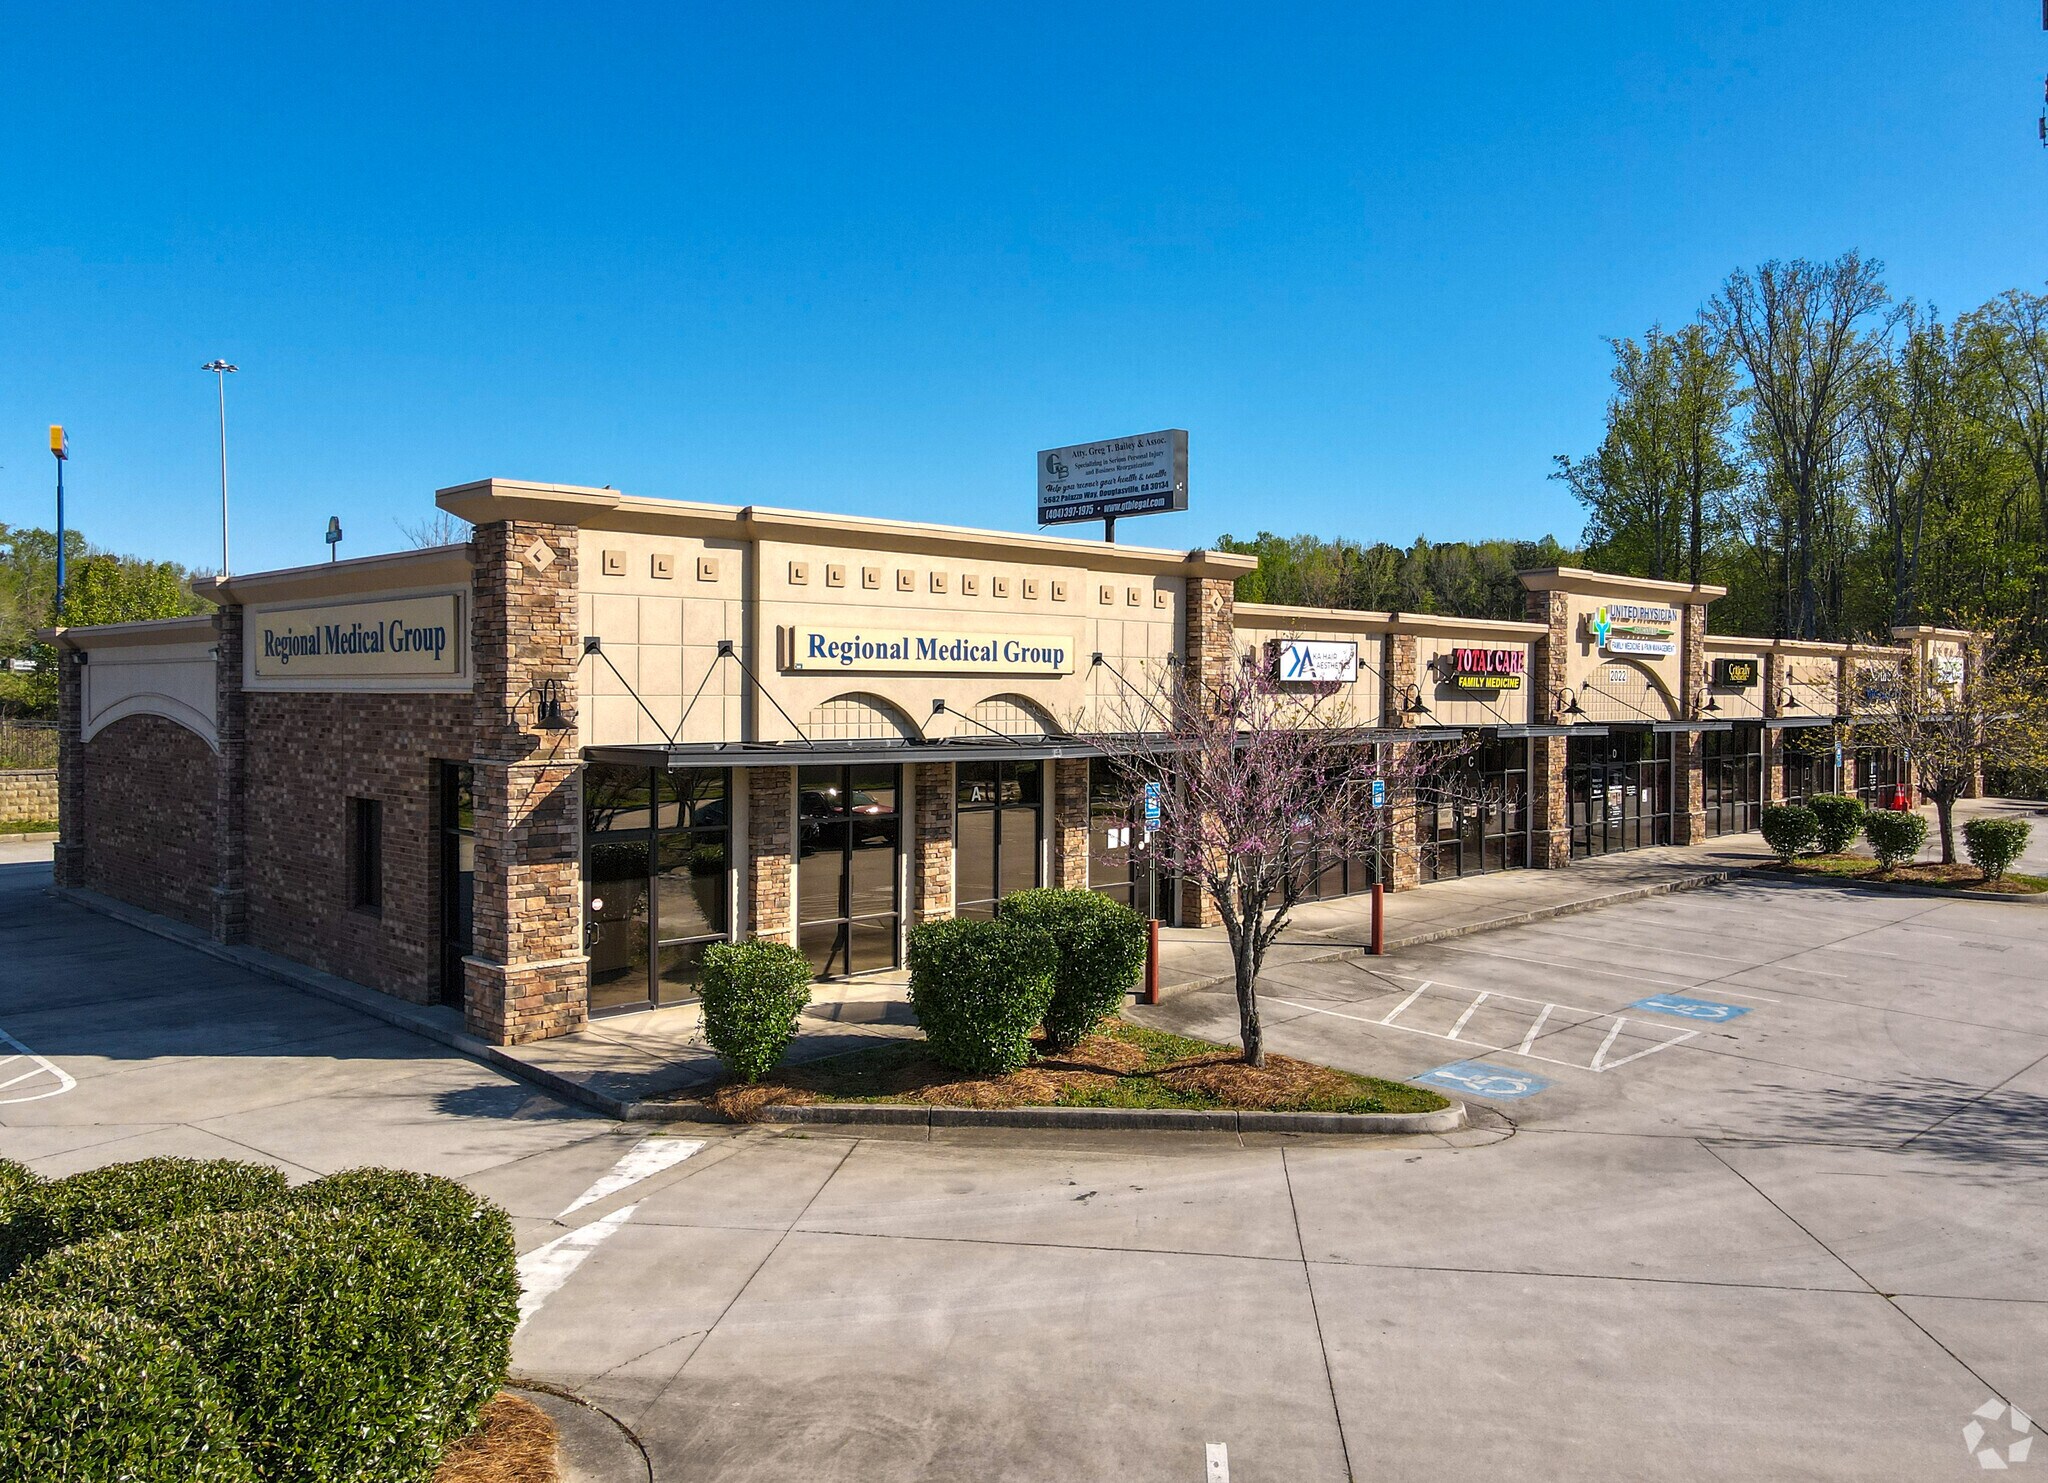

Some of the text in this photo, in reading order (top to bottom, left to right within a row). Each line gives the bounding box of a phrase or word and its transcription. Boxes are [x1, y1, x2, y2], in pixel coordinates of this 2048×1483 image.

[1072, 451, 1087, 459] Atty.
[1089, 447, 1105, 456] Greg
[1115, 442, 1135, 452] Bailey
[1146, 437, 1166, 446] Assoc.
[1074, 460, 1102, 469] Specializing
[1109, 457, 1126, 465] Serious
[1128, 454, 1148, 462] Personal
[1096, 467, 1115, 475] Business
[1046, 482, 1062, 494] Help
[1062, 485, 1074, 494] you
[1100, 479, 1116, 488] your
[1118, 473, 1137, 483] health
[1146, 470, 1166, 480] wealth
[1061, 494, 1082, 502] Palazzo
[1611, 605, 1676, 620] UNITED PHYSICIAN
[264, 620, 446, 664] Regional Medical Group
[807, 634, 1064, 669] Regional Medical Group
[1316, 662, 1350, 670] AESTHES
[1456, 649, 1524, 672] TOTAL CARE
[1458, 676, 1520, 688] FAMILY MEDICINE
[1610, 670, 1626, 682] 2022
[1468, 756, 1474, 767] C
[972, 786, 981, 802] A
